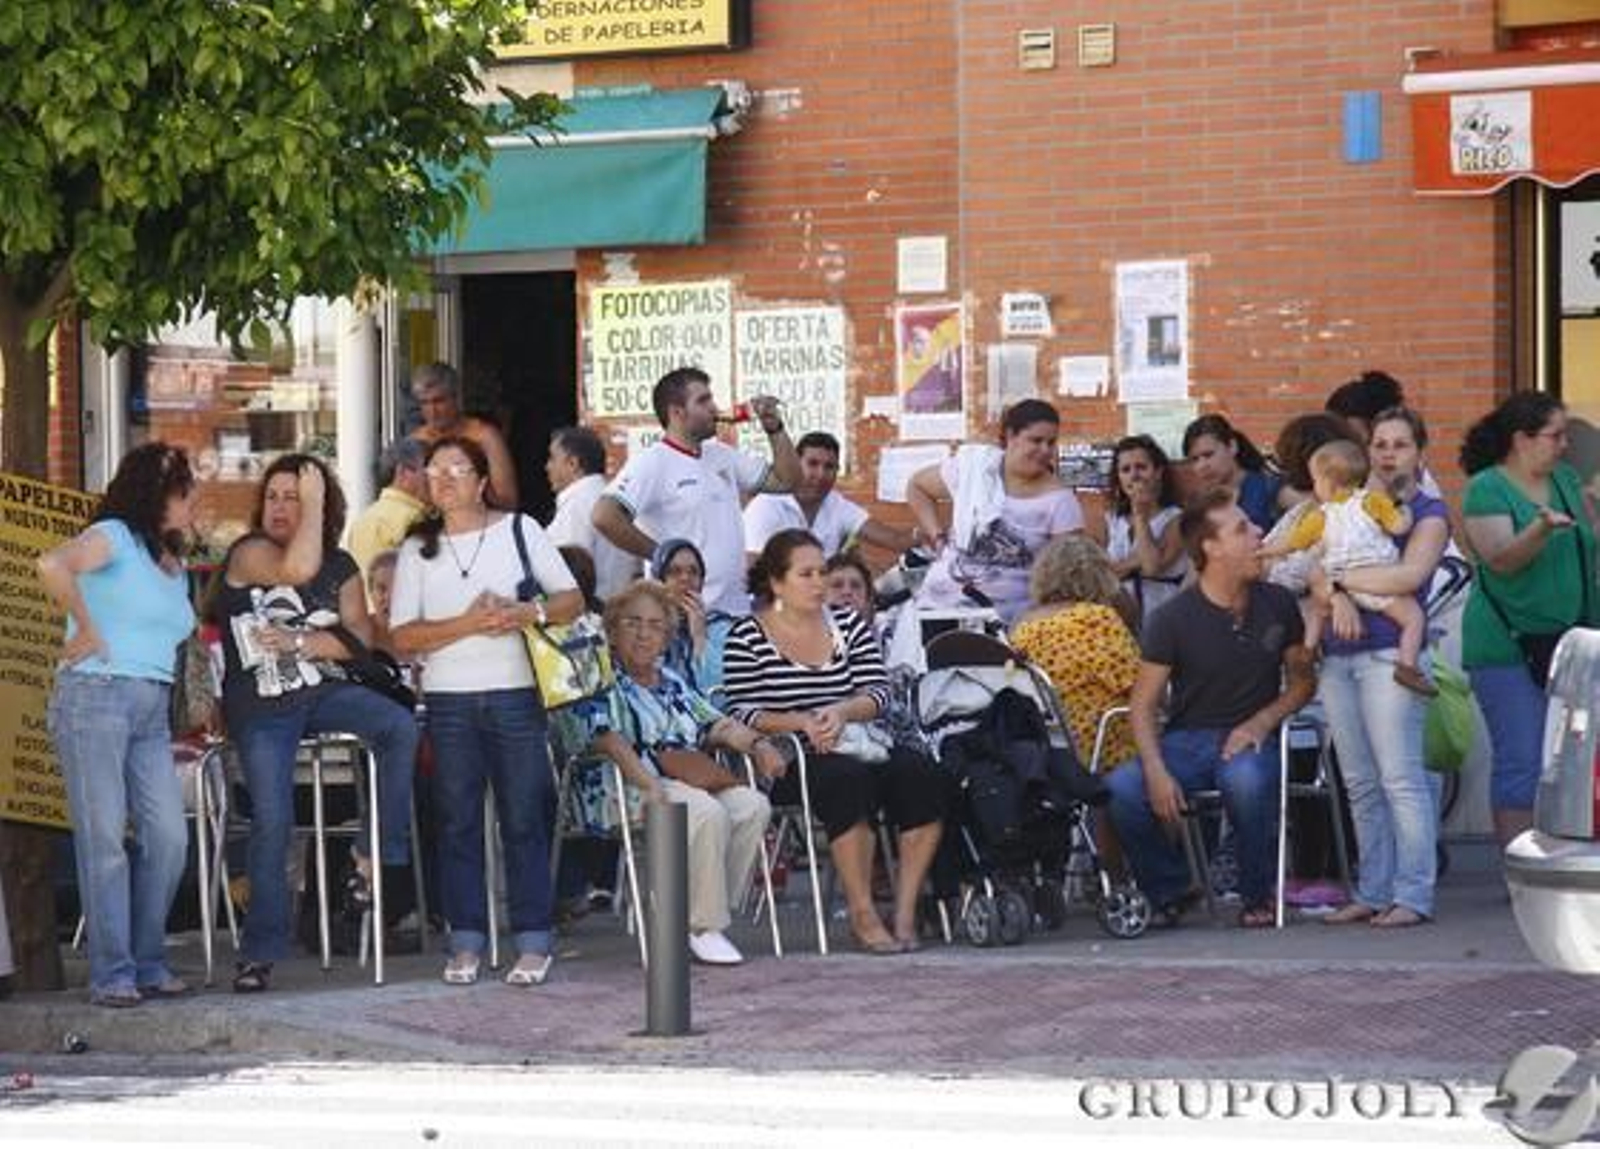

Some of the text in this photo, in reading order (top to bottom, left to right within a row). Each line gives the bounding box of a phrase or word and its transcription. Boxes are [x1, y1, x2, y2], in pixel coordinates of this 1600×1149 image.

[544, 18, 706, 45] DE PAPELERIA
[601, 287, 727, 320] FOTOCOPIAS
[747, 313, 831, 343] OFERTA
[740, 344, 844, 376] TARRINAS
